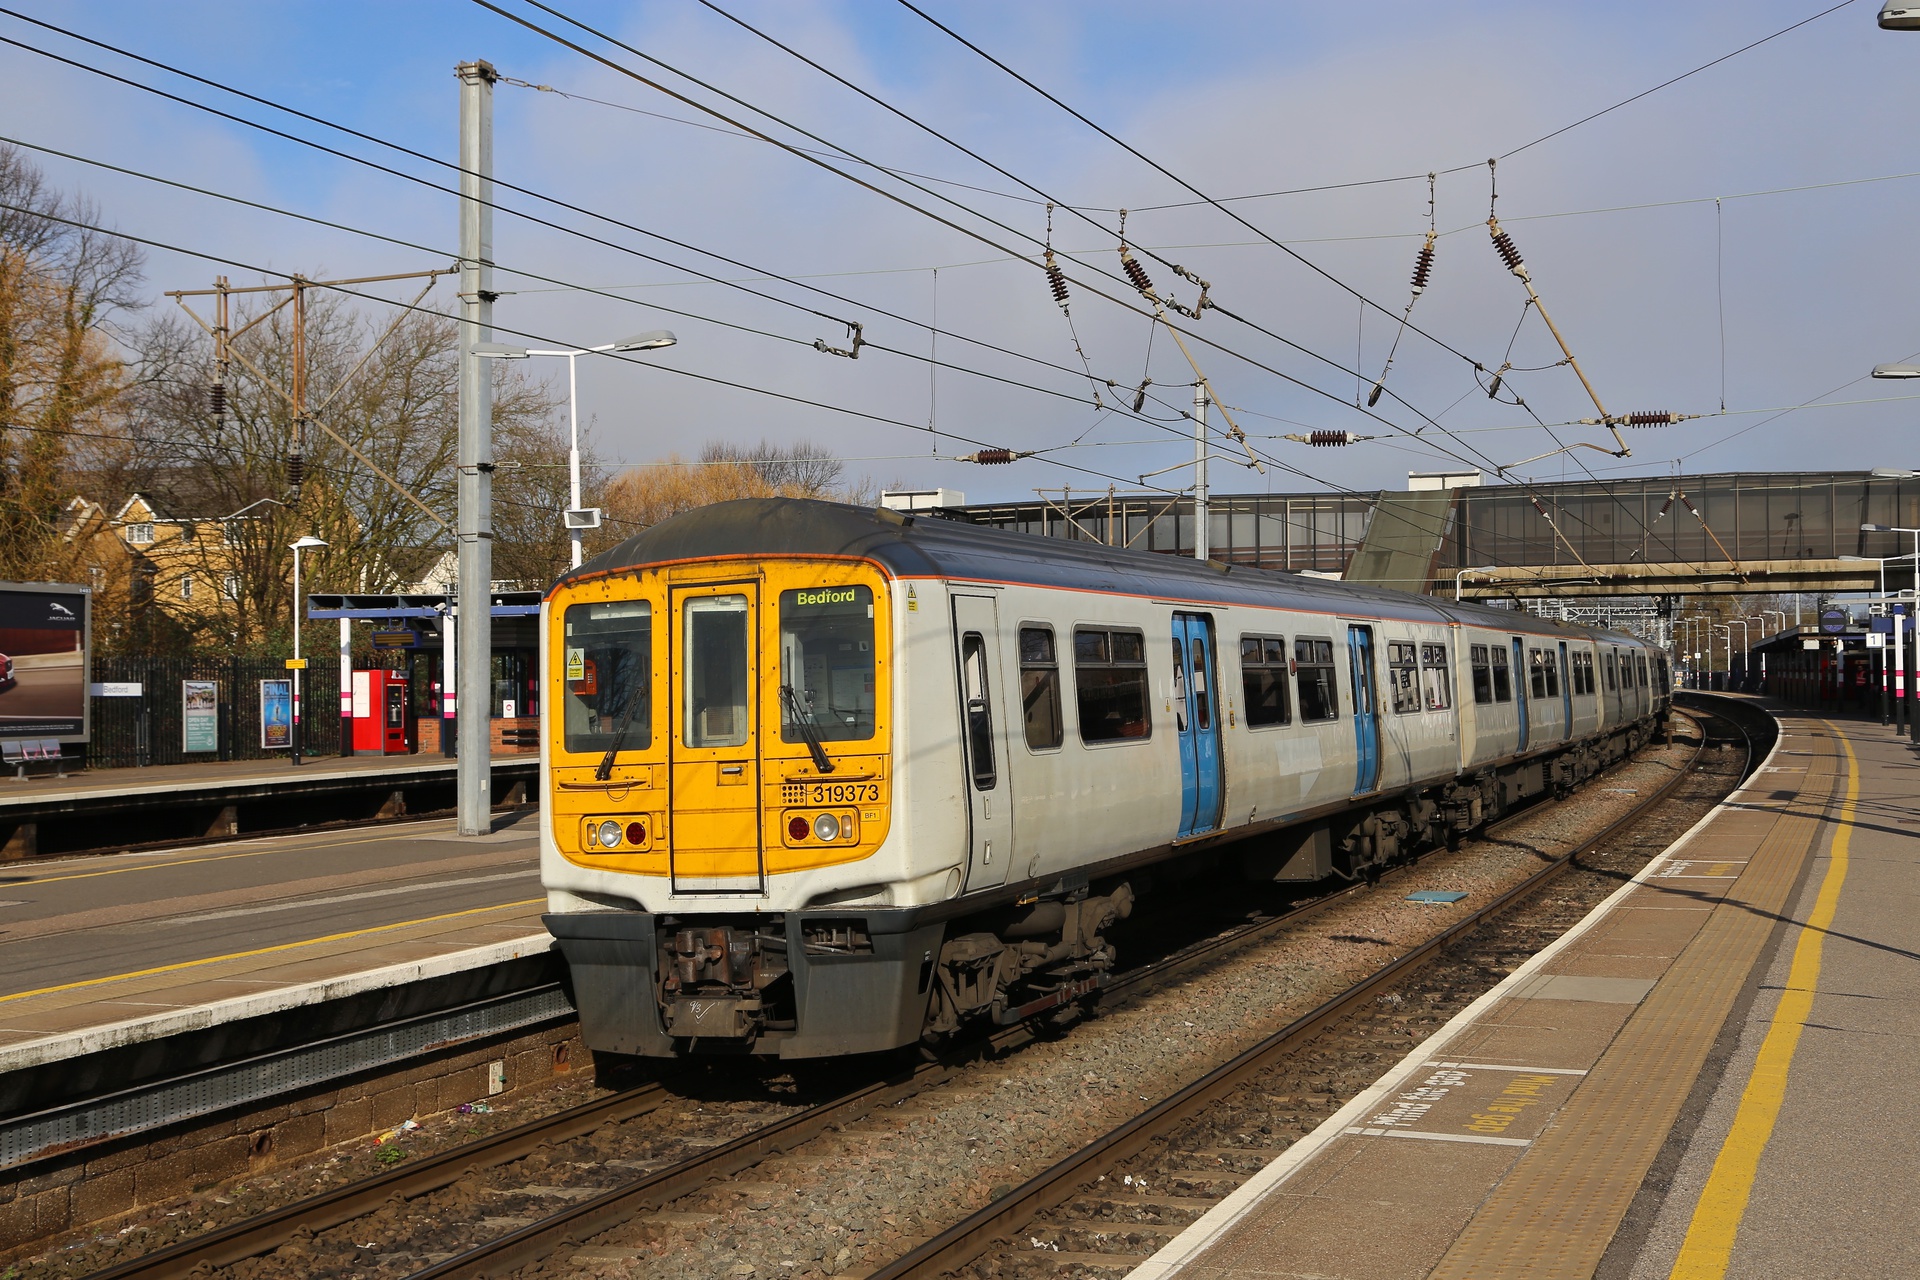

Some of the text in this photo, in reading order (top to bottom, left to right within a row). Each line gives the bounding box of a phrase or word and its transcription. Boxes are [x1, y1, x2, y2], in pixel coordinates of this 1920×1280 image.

[797, 589, 855, 605] Bedford
[1870, 635, 1876, 645] 1
[264, 683, 289, 696] FINAL
[813, 784, 879, 803] 319373
[1367, 1070, 1472, 1127] Mind the gap
[1462, 1074, 1559, 1133] Mind the gap
